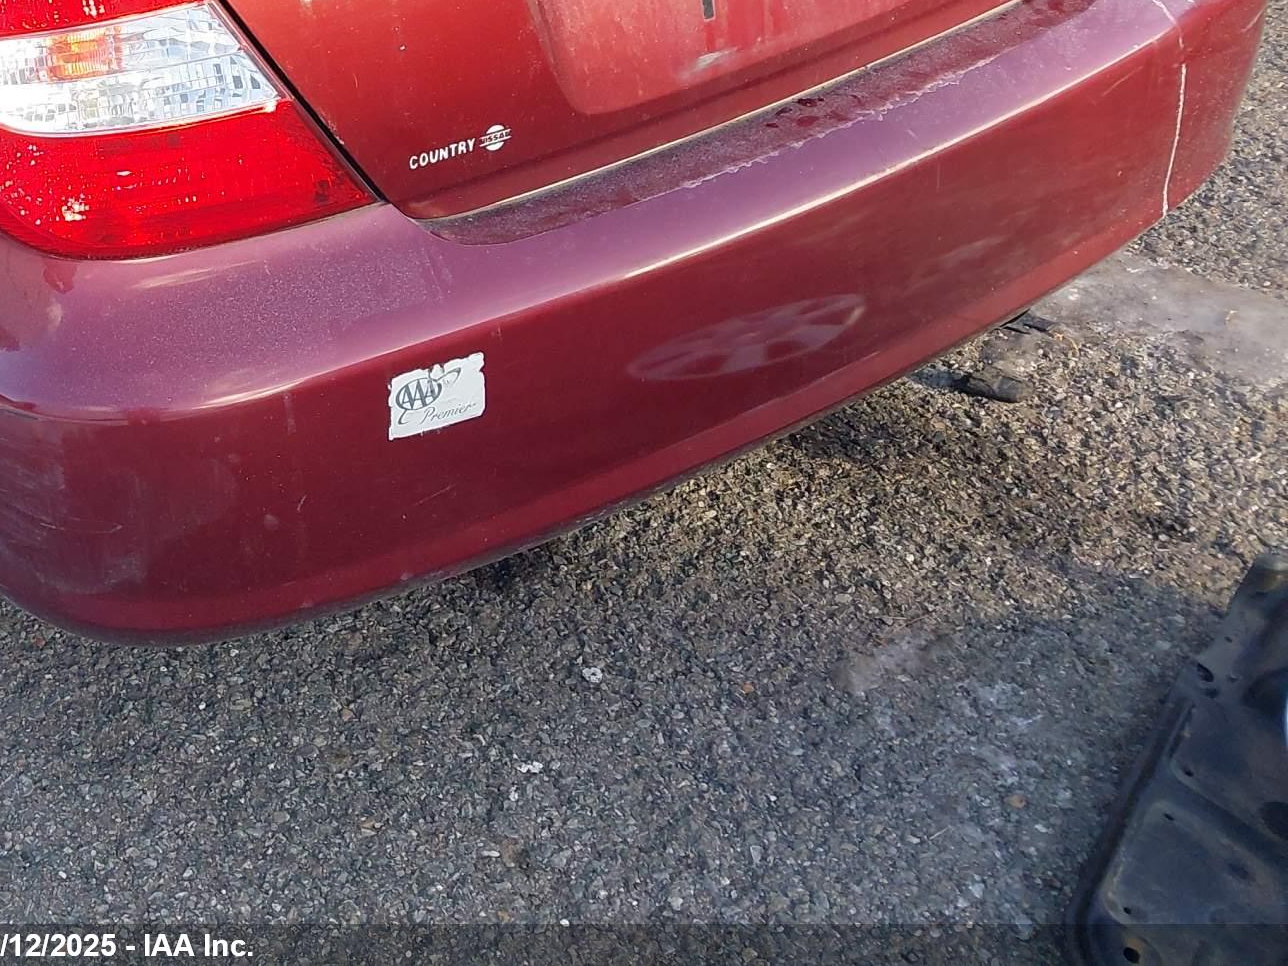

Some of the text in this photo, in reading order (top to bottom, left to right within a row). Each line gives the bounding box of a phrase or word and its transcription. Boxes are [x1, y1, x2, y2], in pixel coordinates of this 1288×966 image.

[409, 138, 475, 170] COUNTRY
[398, 378, 441, 410] AAA
[420, 403, 475, 425] Premier
